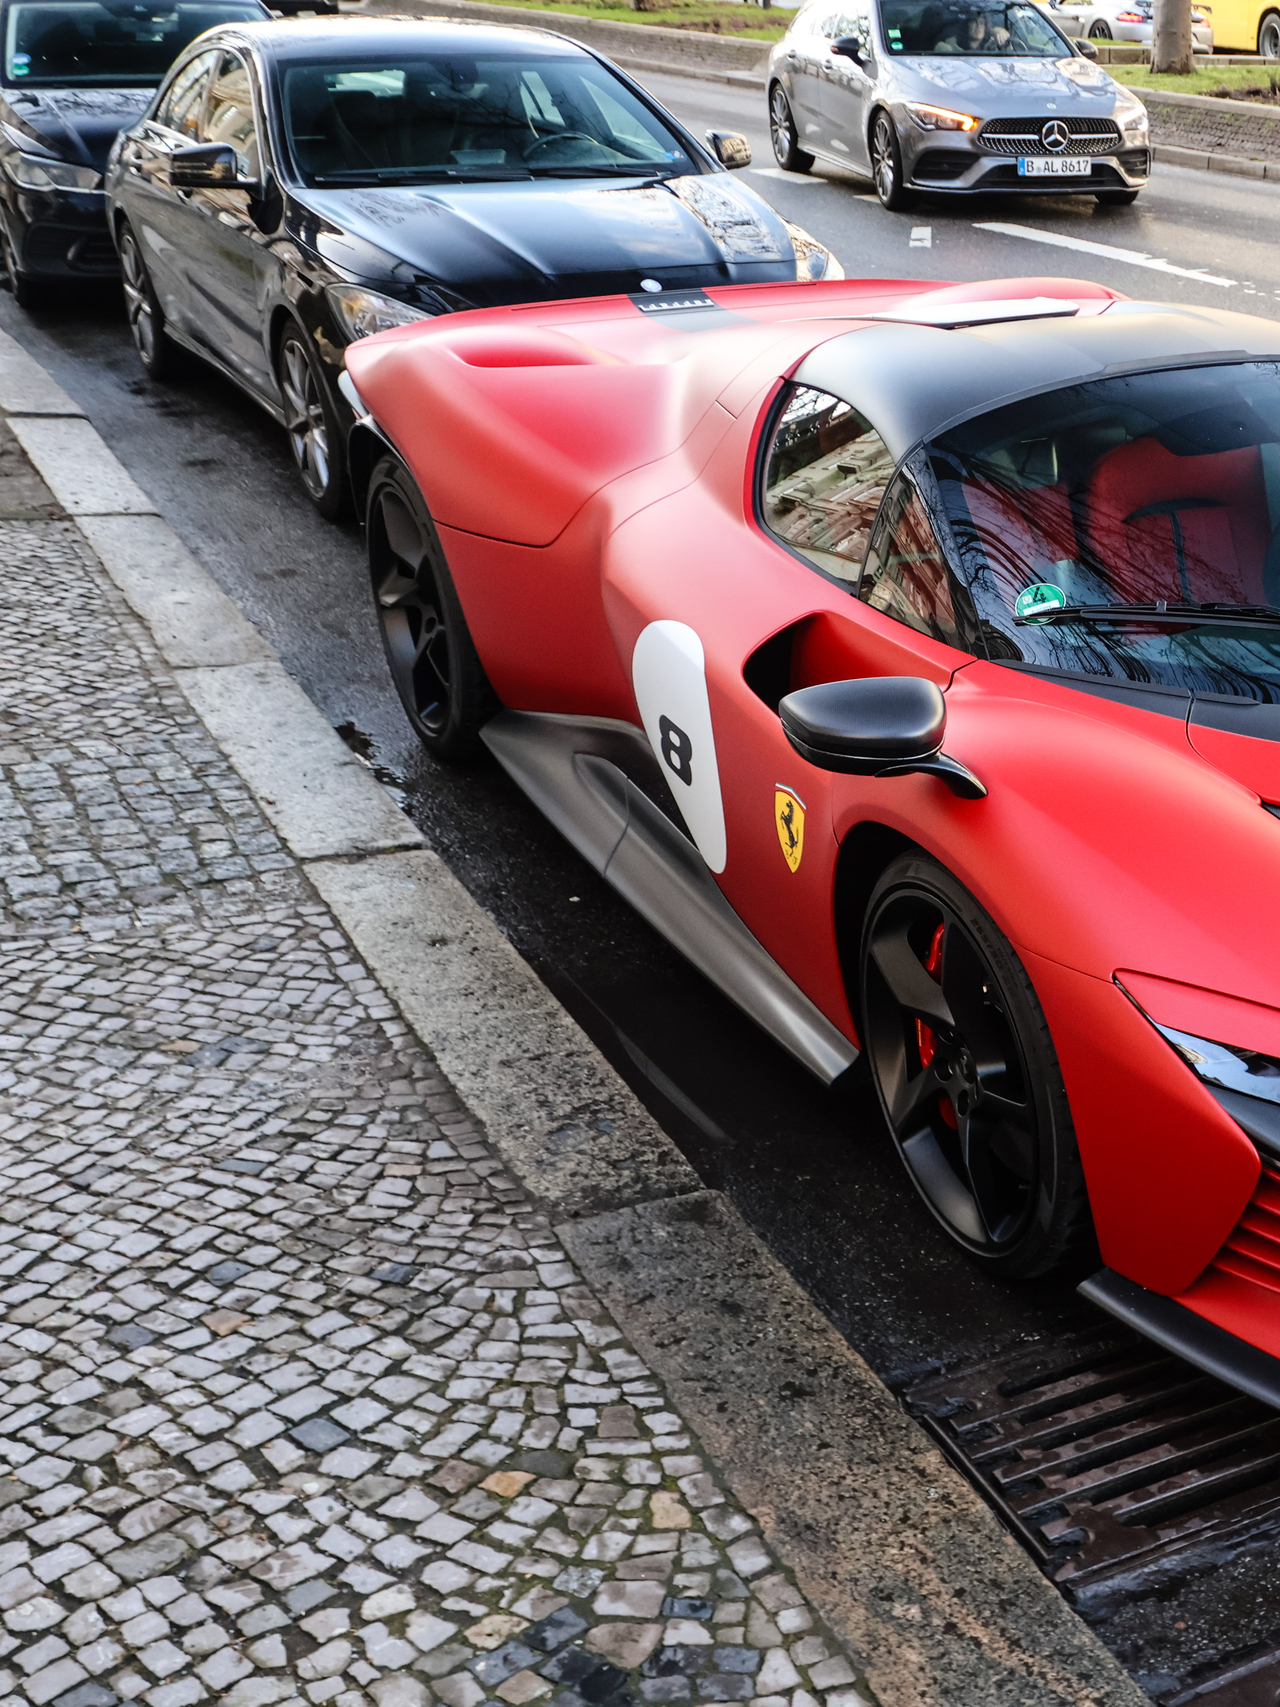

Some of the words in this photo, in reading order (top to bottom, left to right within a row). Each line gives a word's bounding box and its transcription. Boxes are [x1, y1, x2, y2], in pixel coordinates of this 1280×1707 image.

[1026, 160, 1034, 173] B
[1043, 160, 1059, 173] AL
[1061, 159, 1089, 173] 8617
[1033, 586, 1047, 603] 4
[659, 714, 692, 786] 8
